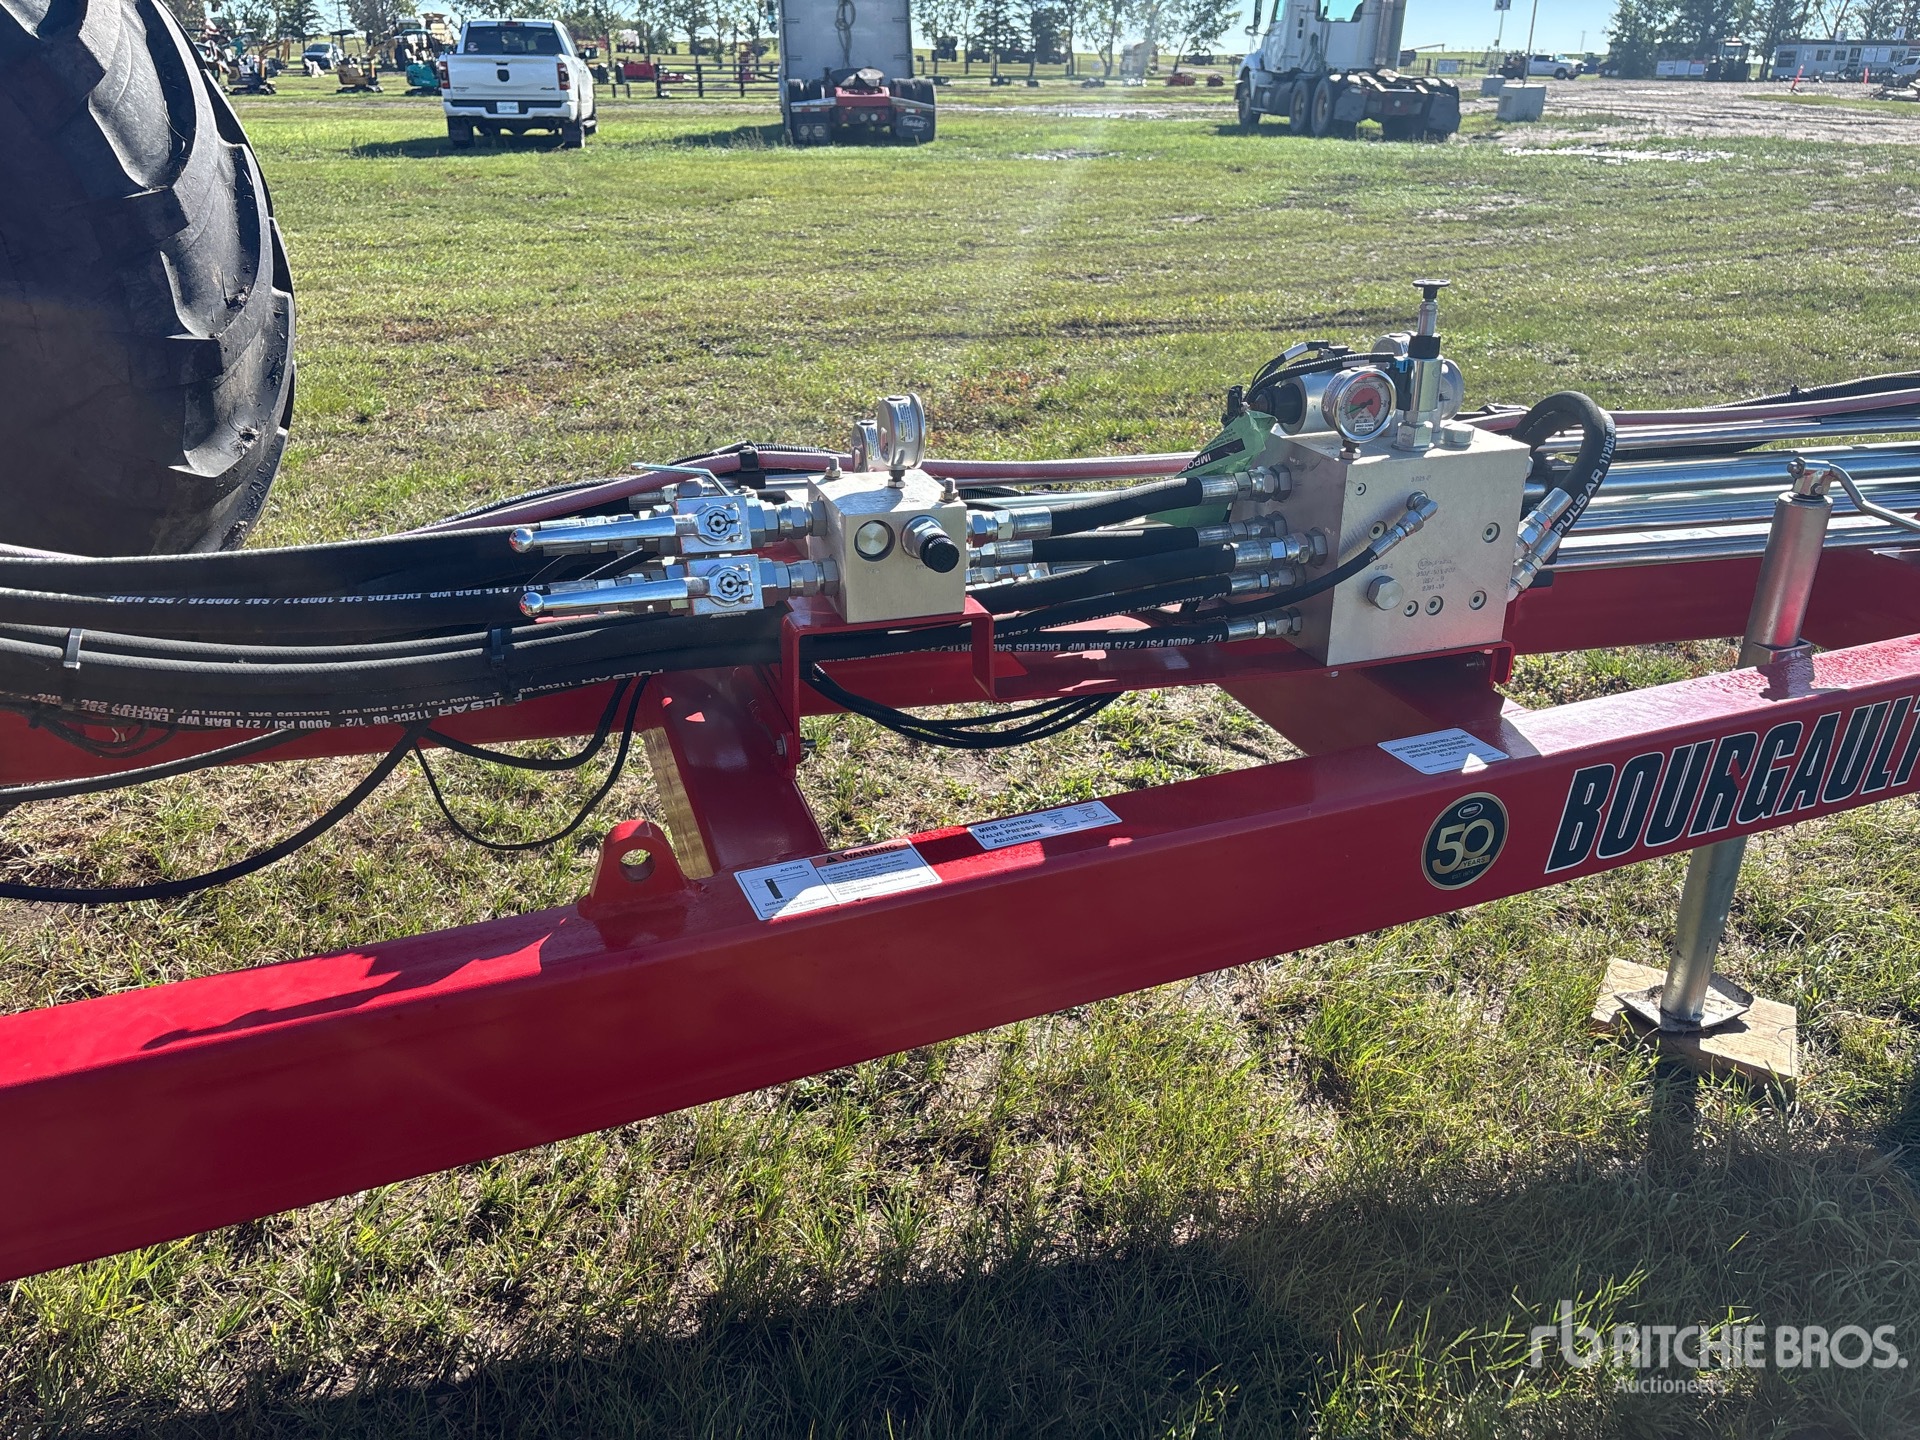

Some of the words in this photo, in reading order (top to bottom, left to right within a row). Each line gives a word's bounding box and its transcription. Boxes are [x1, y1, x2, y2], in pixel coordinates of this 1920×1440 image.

[1554, 468, 1603, 536] PULSAR
[1016, 643, 1061, 652] EXCEEDS
[1089, 642, 1111, 651] BAR
[1146, 639, 1164, 648] PSI
[177, 715, 201, 726] WP
[204, 717, 232, 728] BAR
[373, 709, 432, 725] 112CC-08
[235, 719, 261, 729] 275
[274, 720, 295, 730] PSI
[299, 719, 332, 730] 4000
[978, 824, 998, 833] MRB
[999, 818, 1036, 830] CONTROL
[979, 831, 1004, 841] VALVE
[1006, 823, 1046, 835] PRESSURE
[993, 831, 1042, 845] ADJUSTMENT
[1432, 818, 1495, 875] 50
[841, 845, 899, 860] WARNING
[1463, 856, 1487, 868] YEARS
[779, 864, 804, 874] ACTIVE
